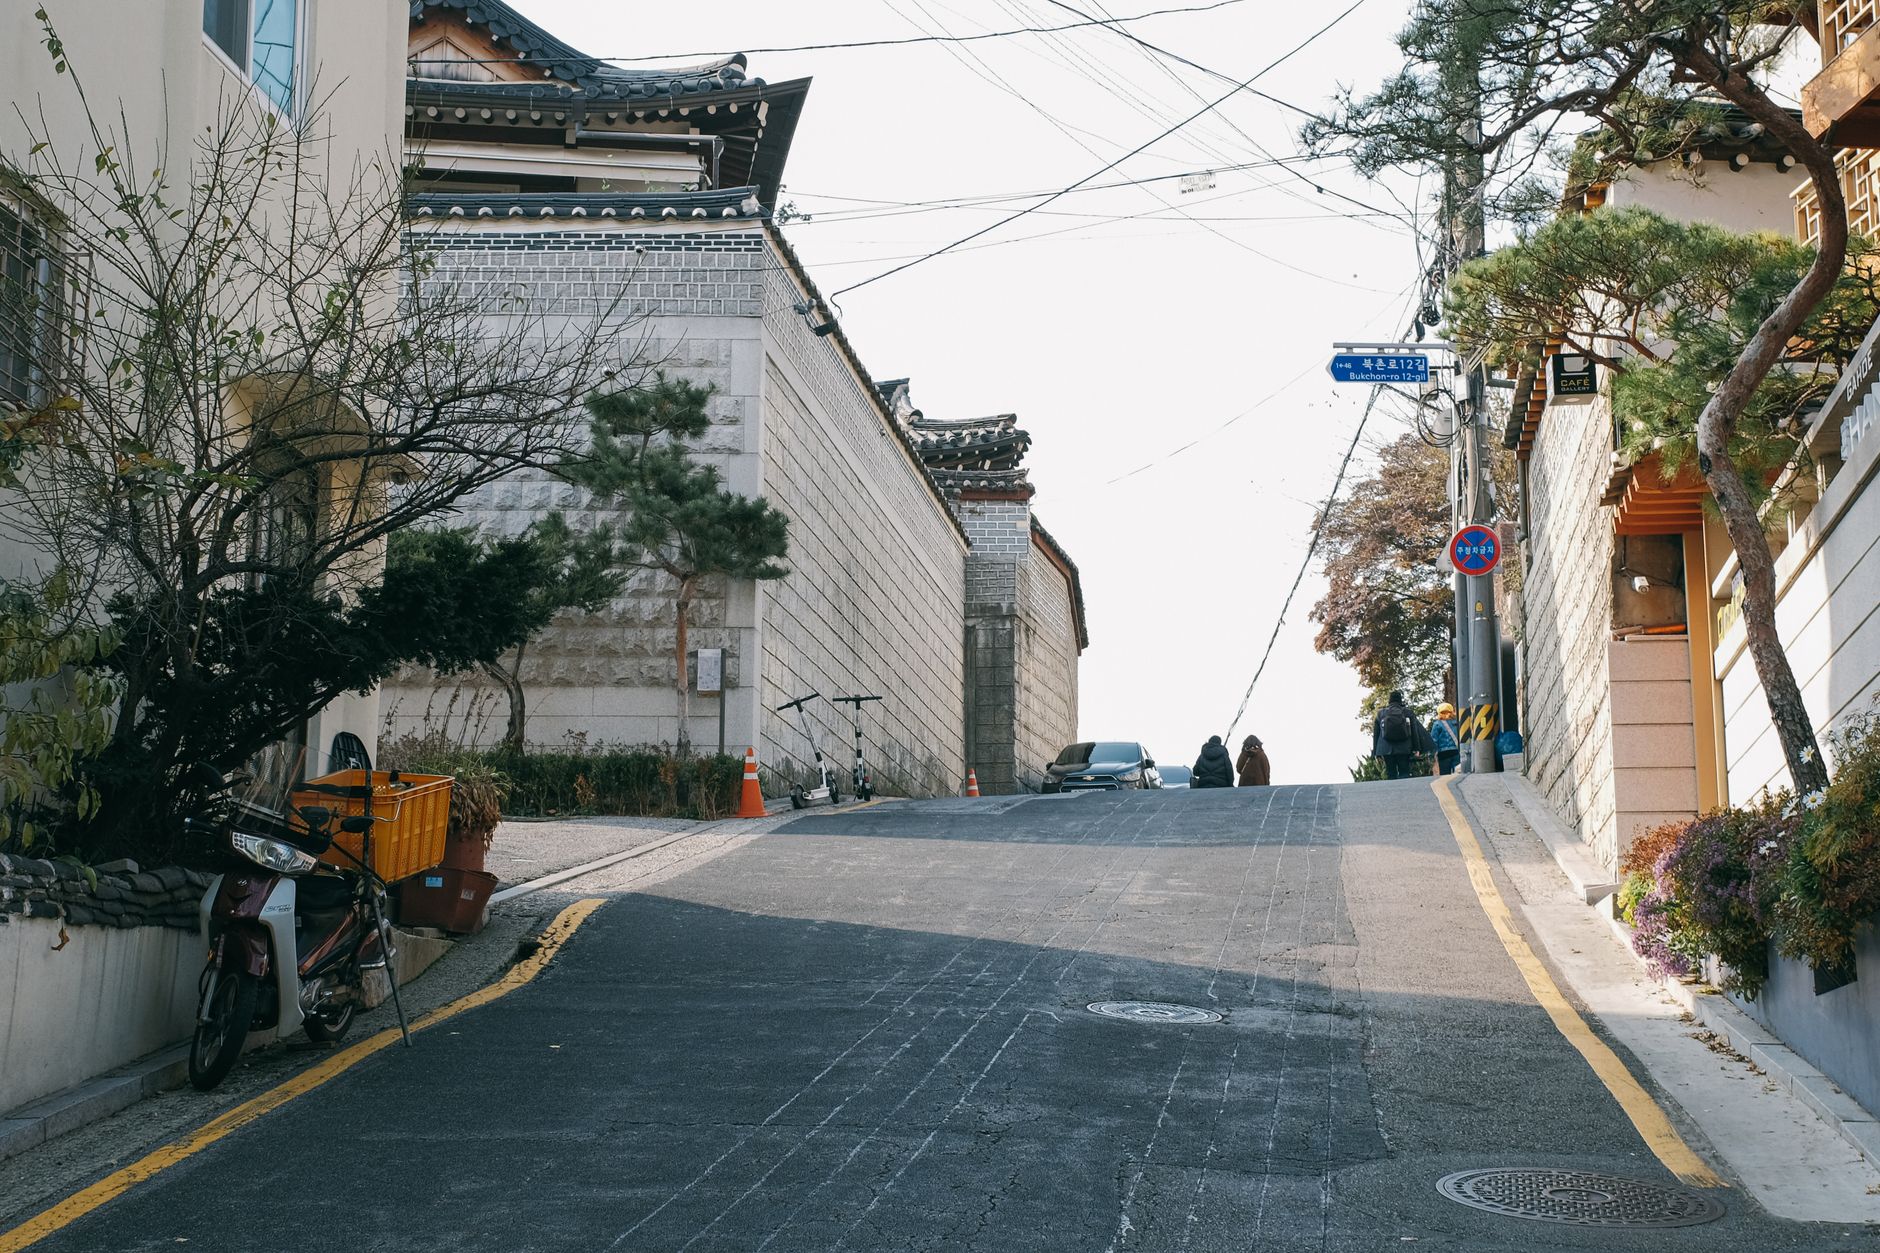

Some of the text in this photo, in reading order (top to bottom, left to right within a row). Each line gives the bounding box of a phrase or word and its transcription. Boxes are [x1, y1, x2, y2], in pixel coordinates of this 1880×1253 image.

[1362, 359, 1425, 371] 북촌로12길
[1349, 372, 1426, 382] Bukchon-ro 12-gil
[1560, 377, 1589, 386] CAFÉ
[1457, 546, 1494, 555] 주정차금지
